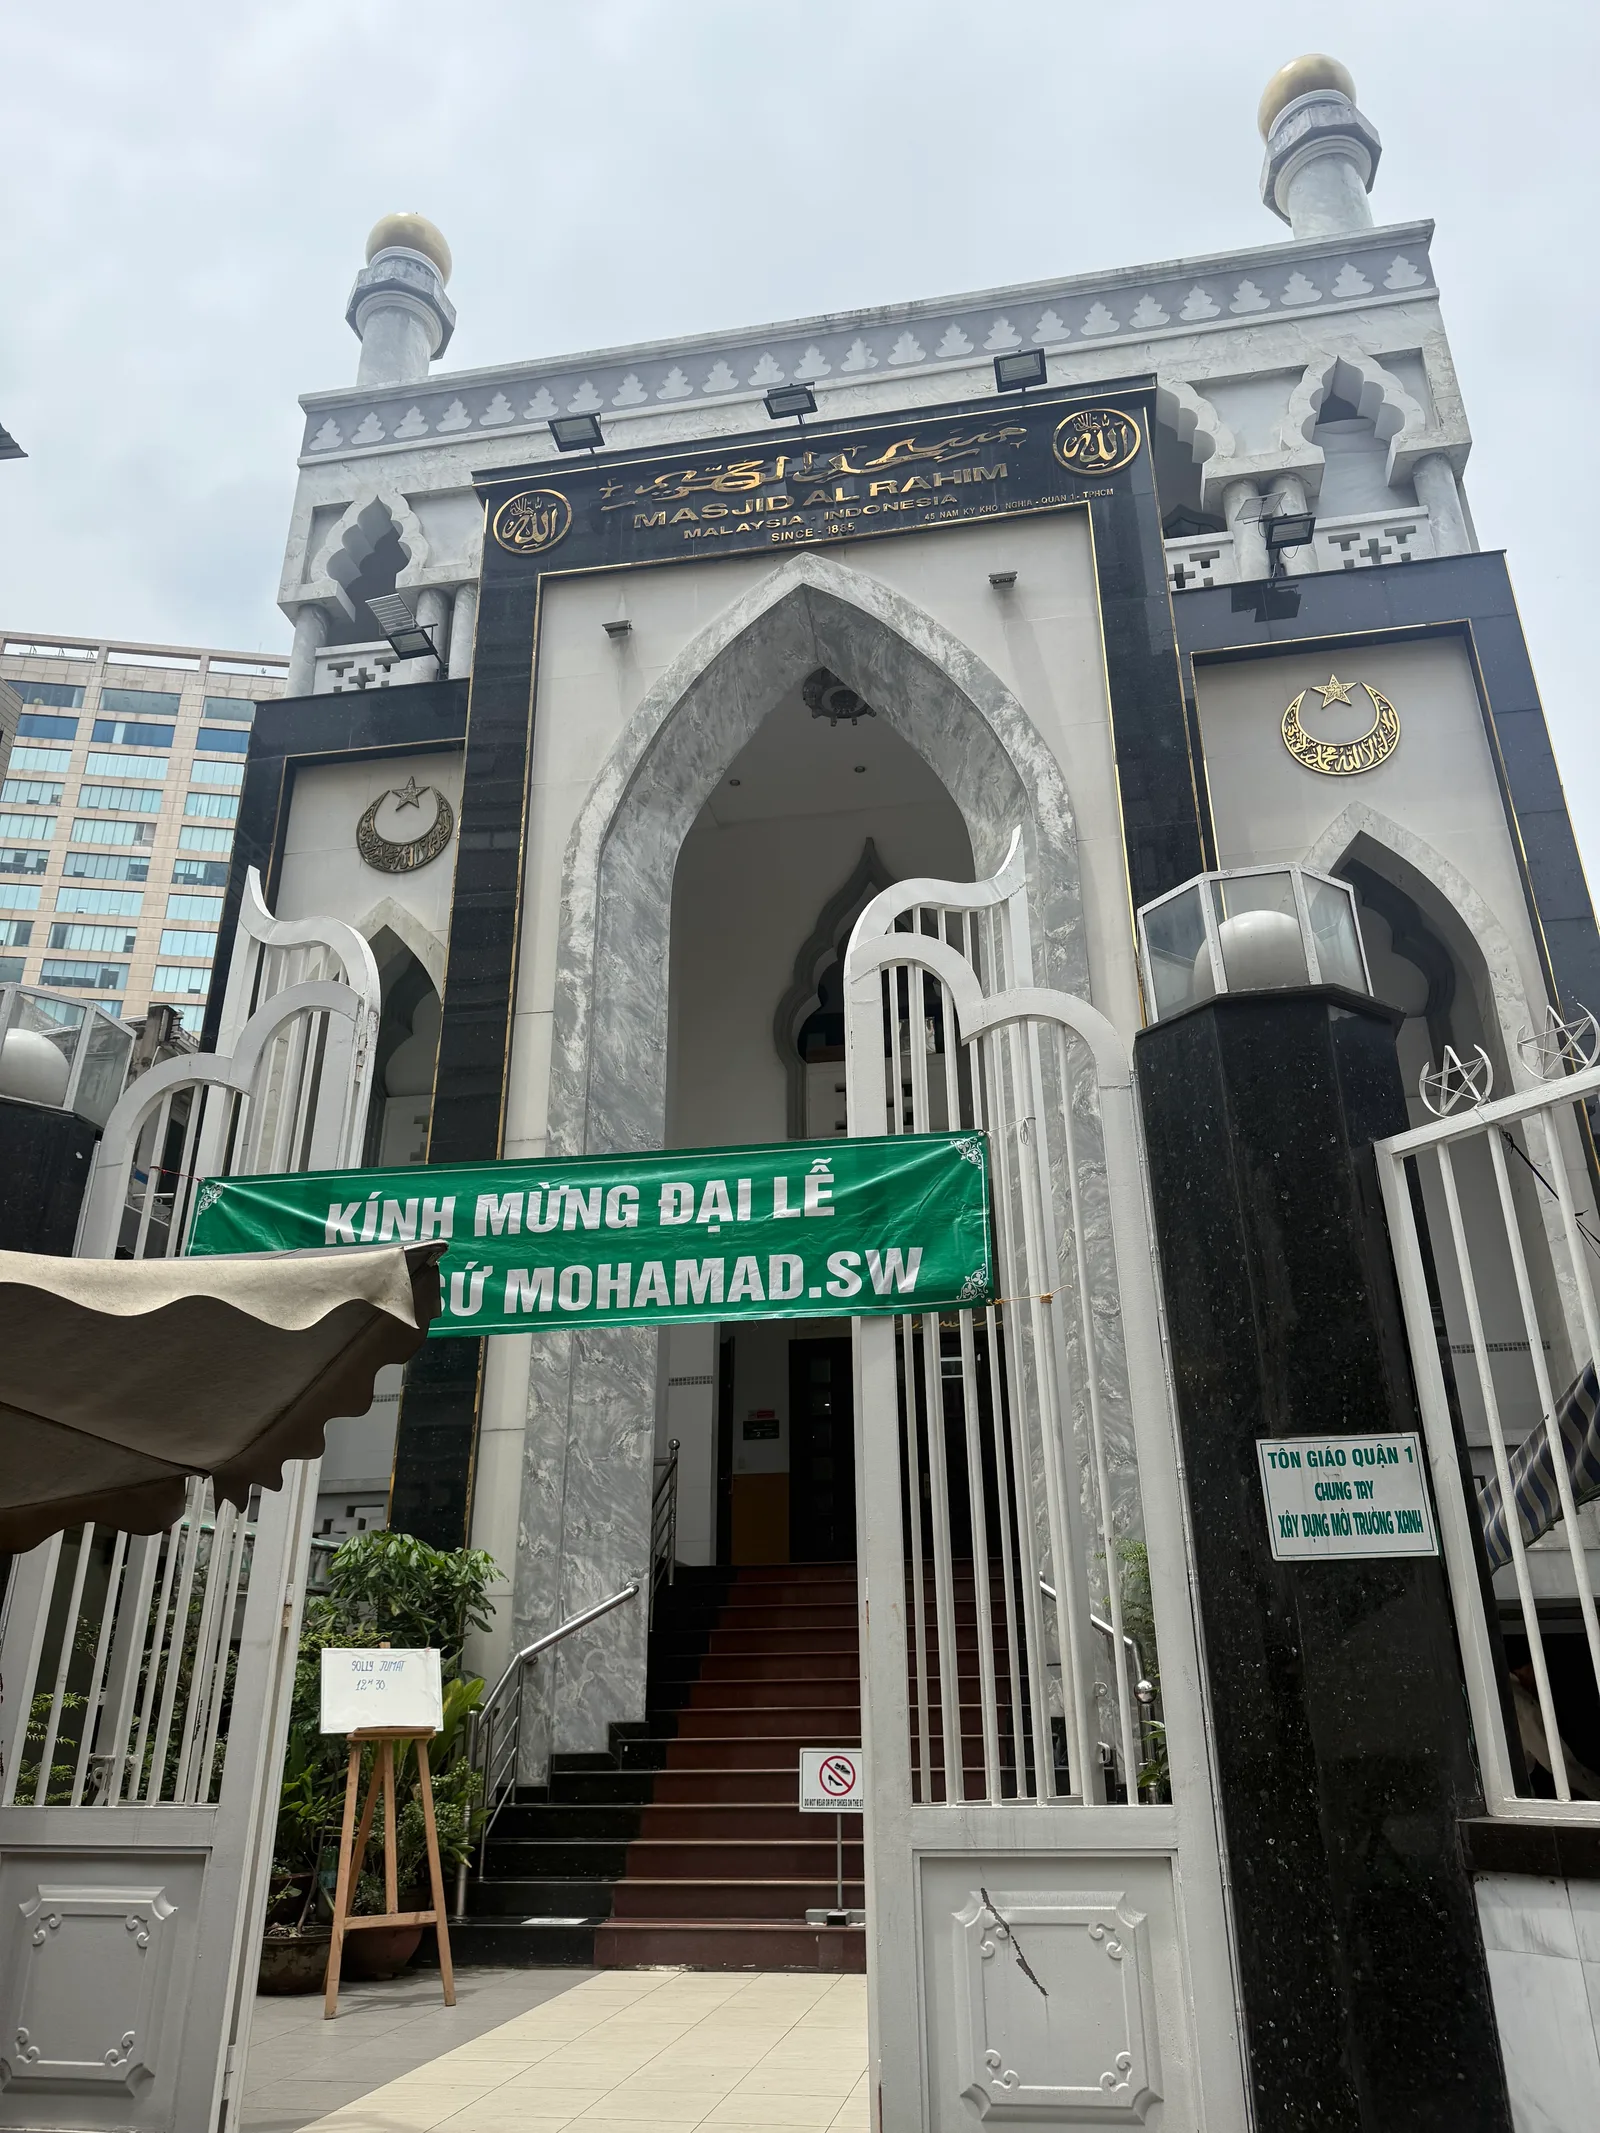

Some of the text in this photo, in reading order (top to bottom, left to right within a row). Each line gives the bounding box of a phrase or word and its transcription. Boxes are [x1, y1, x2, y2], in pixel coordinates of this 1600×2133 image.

[633, 463, 1008, 529] MASJID AL RAHIM
[924, 513, 935, 521] 45
[940, 509, 959, 519] NAM
[963, 507, 975, 515] KY
[1005, 499, 1033, 510] NGHIA
[1041, 494, 1067, 504] QUAN
[1082, 488, 1114, 498] TPHCM
[683, 515, 804, 540] MALAYSIA
[824, 494, 958, 521] INDONESIA
[771, 528, 814, 542] SINCE
[826, 522, 855, 535] 1885
[325, 1157, 835, 1244] KÍNH MỪNG ĐẠI LỄ
[504, 1247, 923, 1314] MOHAMAD.SW
[1268, 1443, 1414, 1469] TÔN GIÁO QUẬN 1
[1314, 1480, 1374, 1501] CHUNG TAY
[1278, 1509, 1299, 1538] XÂY
[1330, 1507, 1353, 1536] MÔI
[1394, 1509, 1424, 1534] XANH
